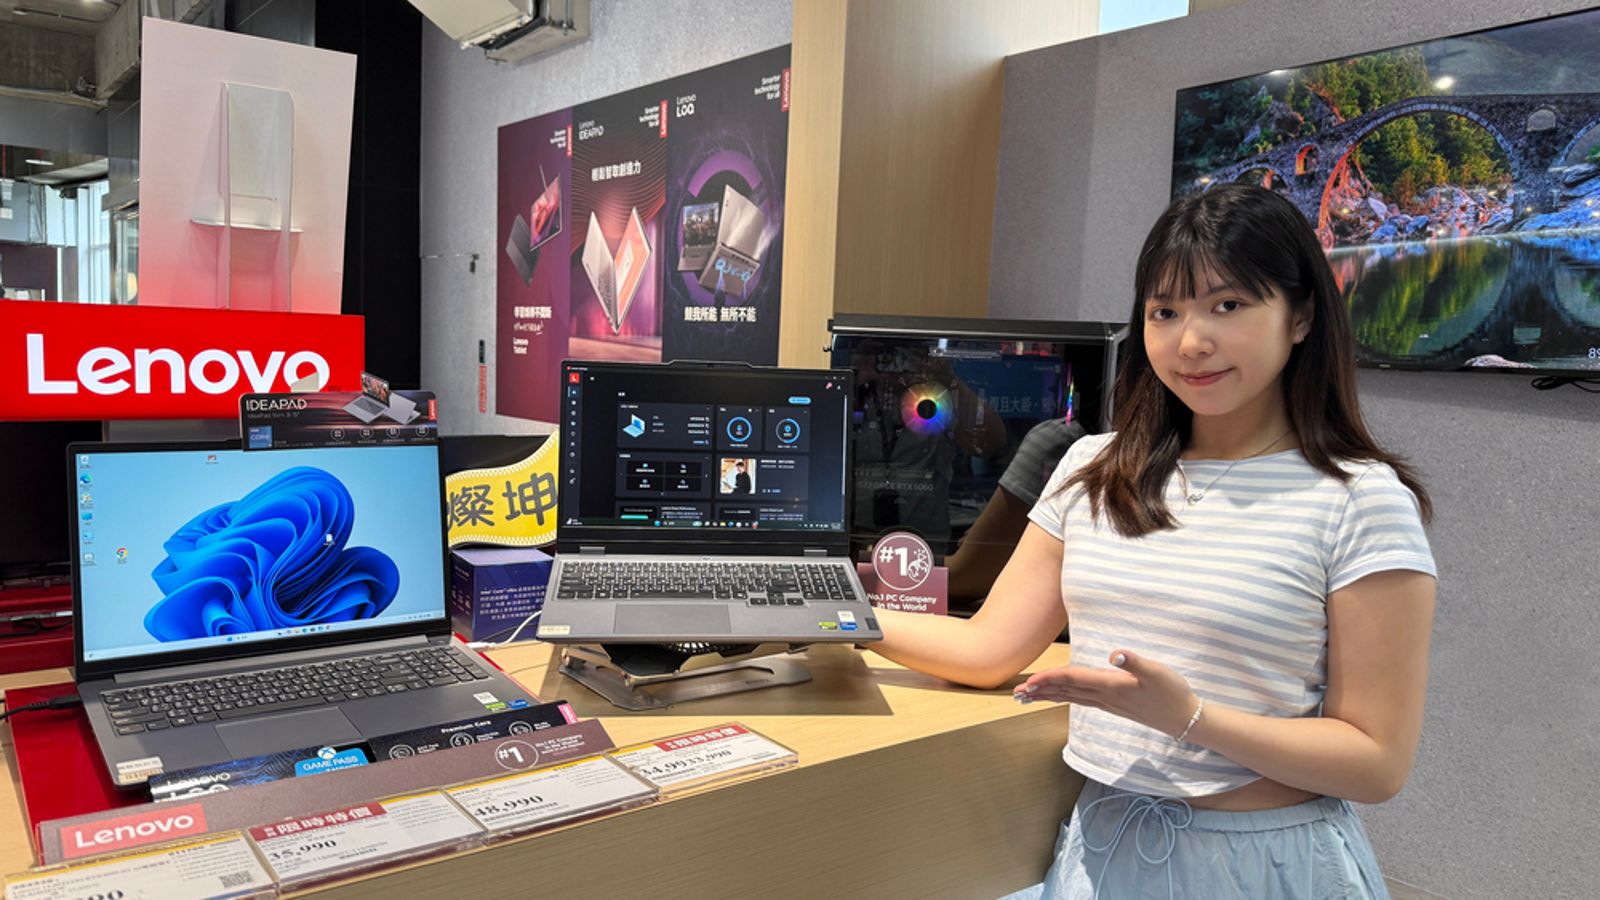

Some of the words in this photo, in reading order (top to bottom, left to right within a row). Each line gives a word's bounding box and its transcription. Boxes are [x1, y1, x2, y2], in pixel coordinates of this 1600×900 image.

[27, 333, 330, 395] Lenovo
[246, 398, 308, 412] IDEAPAD
[447, 472, 558, 531] 燦坤
[879, 546, 908, 577] #1
[887, 602, 901, 610] the
[902, 603, 927, 611] World
[899, 594, 937, 605] Company
[303, 760, 332, 772] GAME
[334, 755, 358, 767] PASS
[499, 746, 524, 763] #1
[474, 795, 544, 817] 48,990
[75, 815, 194, 848] Lenovo
[276, 806, 372, 835] 限時特價
